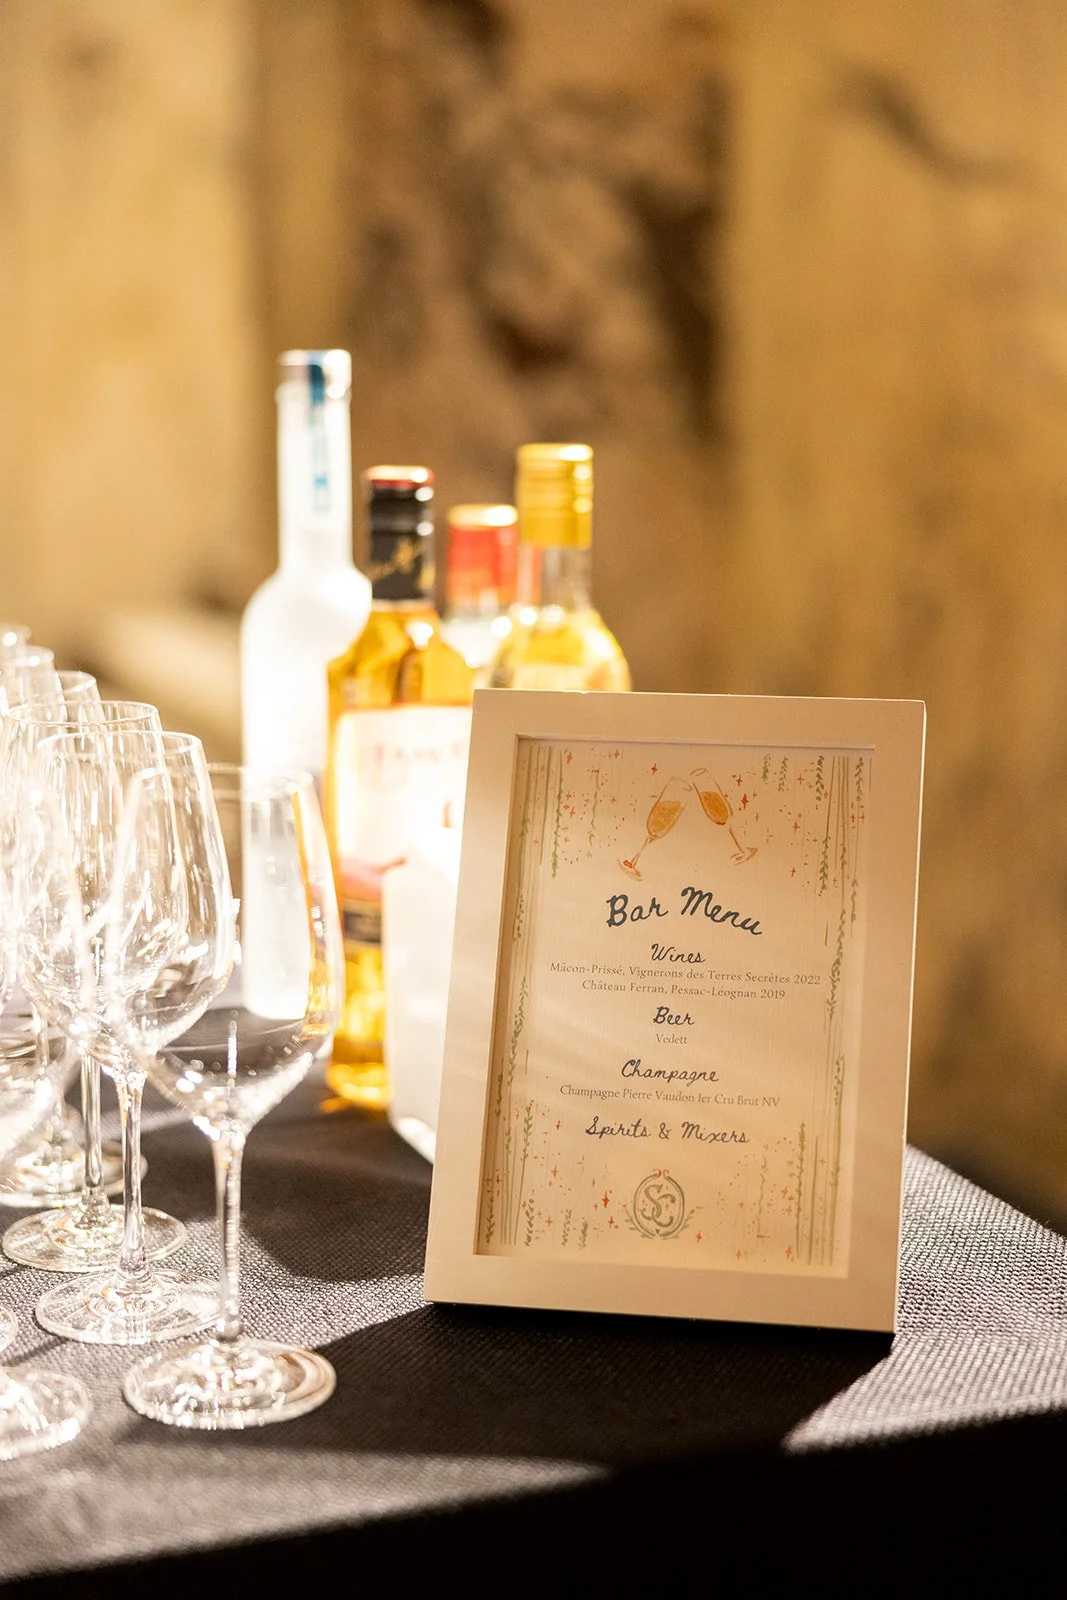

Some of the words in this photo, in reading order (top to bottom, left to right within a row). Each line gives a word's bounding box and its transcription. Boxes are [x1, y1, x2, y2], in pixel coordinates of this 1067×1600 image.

[606, 894, 669, 928] Bar
[681, 886, 763, 935] Menu
[651, 944, 705, 963] Wines
[629, 966, 683, 979] Vignerons
[686, 968, 704, 979] des
[708, 970, 742, 981] Terres
[745, 972, 790, 983] Secrètes
[794, 974, 820, 985] 2022
[582, 980, 626, 992] Château
[630, 982, 668, 994] Ferran,
[671, 985, 757, 999] Pessac-Léognan
[761, 989, 786, 999] 2019
[653, 1006, 695, 1026] Beer
[656, 1033, 687, 1045] Vedett
[621, 1059, 719, 1087] Champagne
[560, 1085, 621, 1100] Champagne
[623, 1089, 653, 1100] Pierre
[655, 1091, 695, 1102] Vaudon
[715, 1094, 734, 1105] Cru
[737, 1095, 759, 1106] Brut
[762, 1096, 780, 1107] NV
[586, 1116, 652, 1140] Spirits
[659, 1123, 671, 1139] &
[682, 1122, 750, 1143] Mixers
